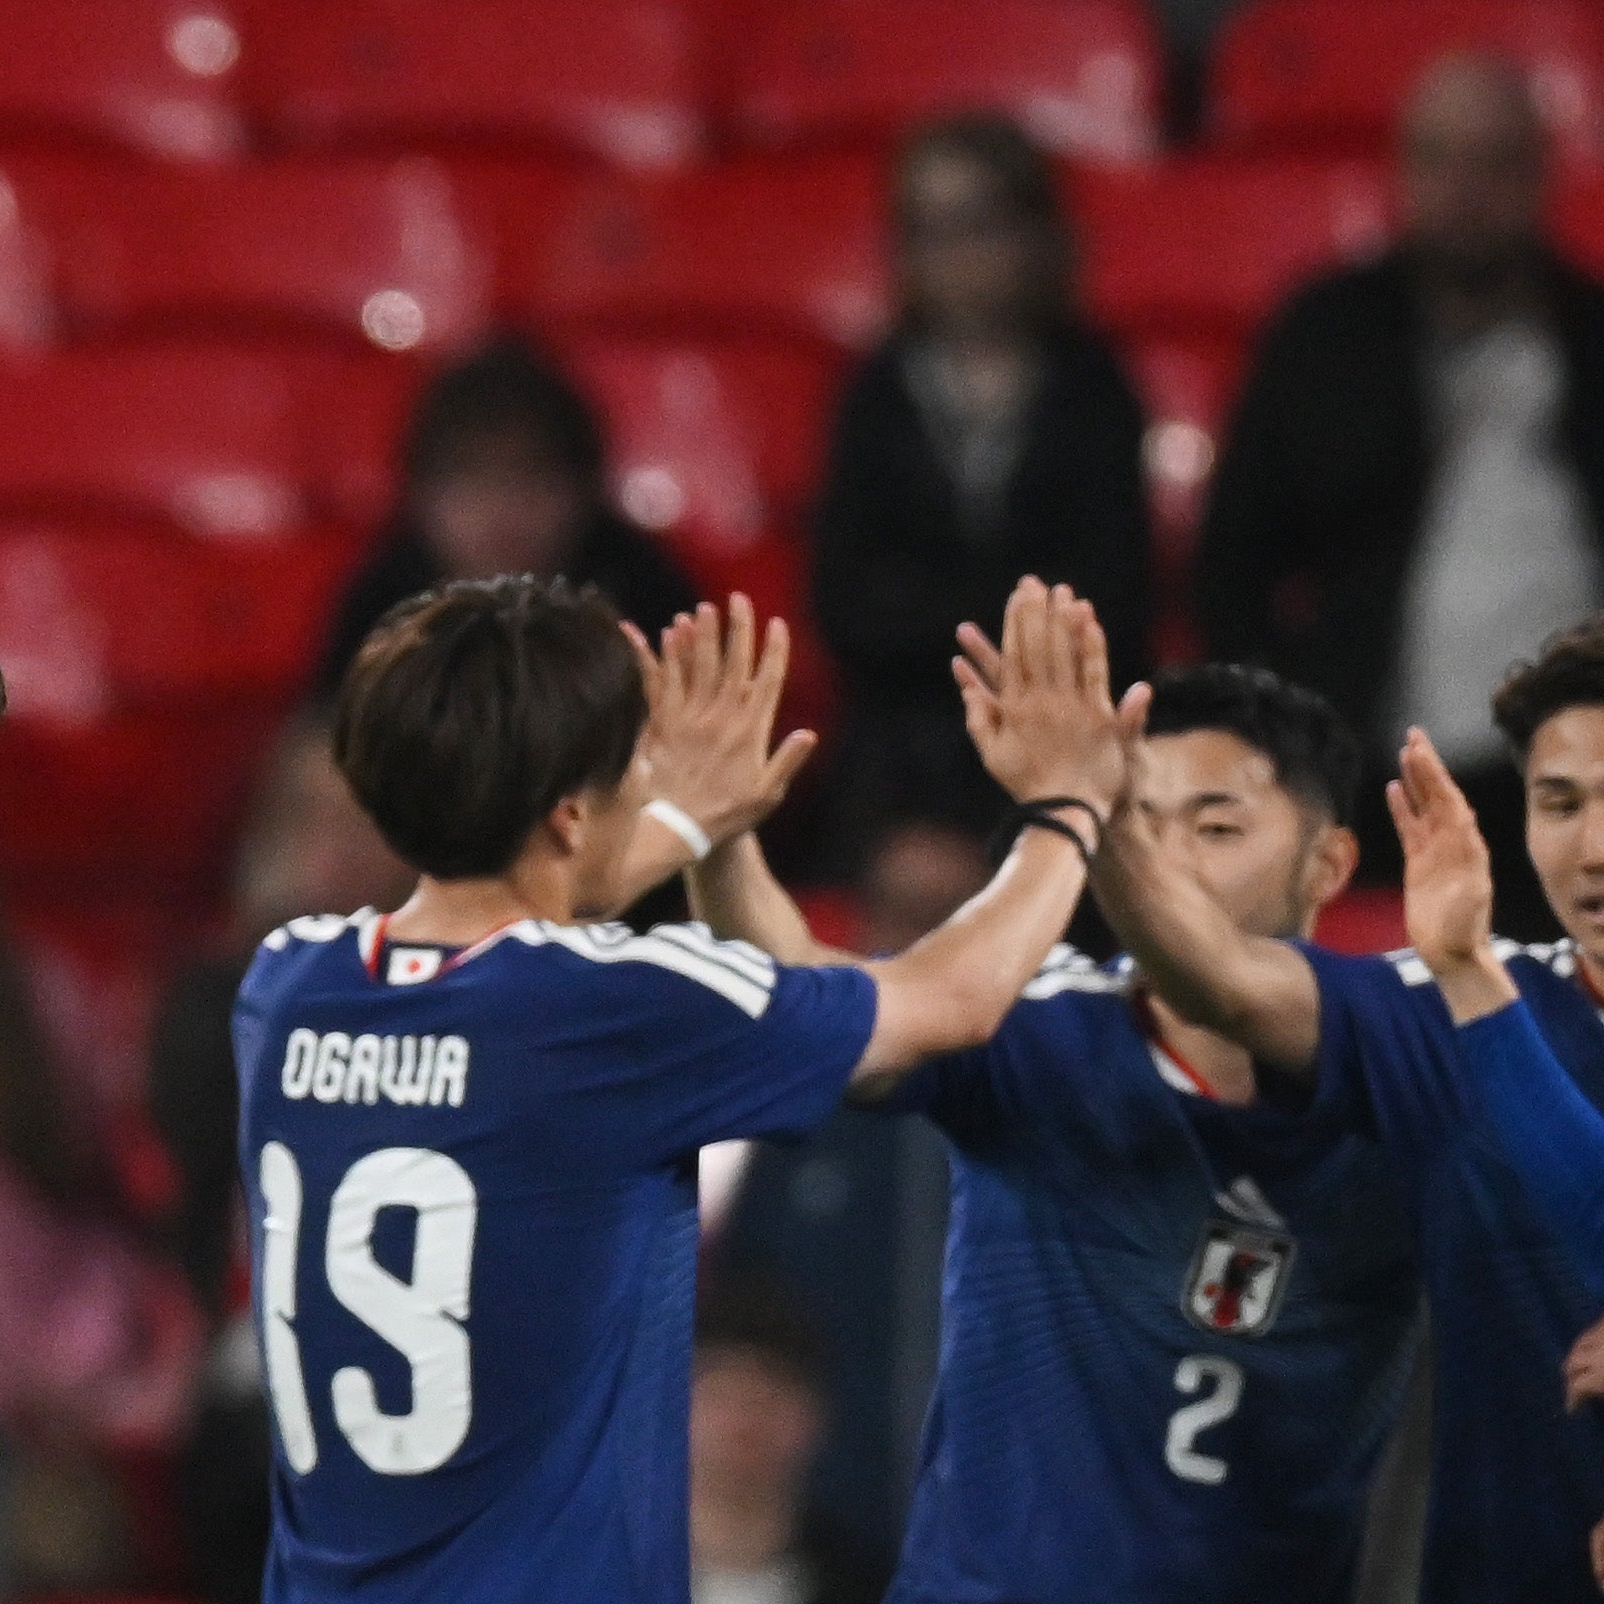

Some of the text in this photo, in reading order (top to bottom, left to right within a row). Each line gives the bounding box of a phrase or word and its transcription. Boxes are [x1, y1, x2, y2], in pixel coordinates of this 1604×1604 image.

[282, 1027, 470, 1107] OGAWA
[260, 1140, 477, 1476] 19
[1164, 1353, 1243, 1485] 2
